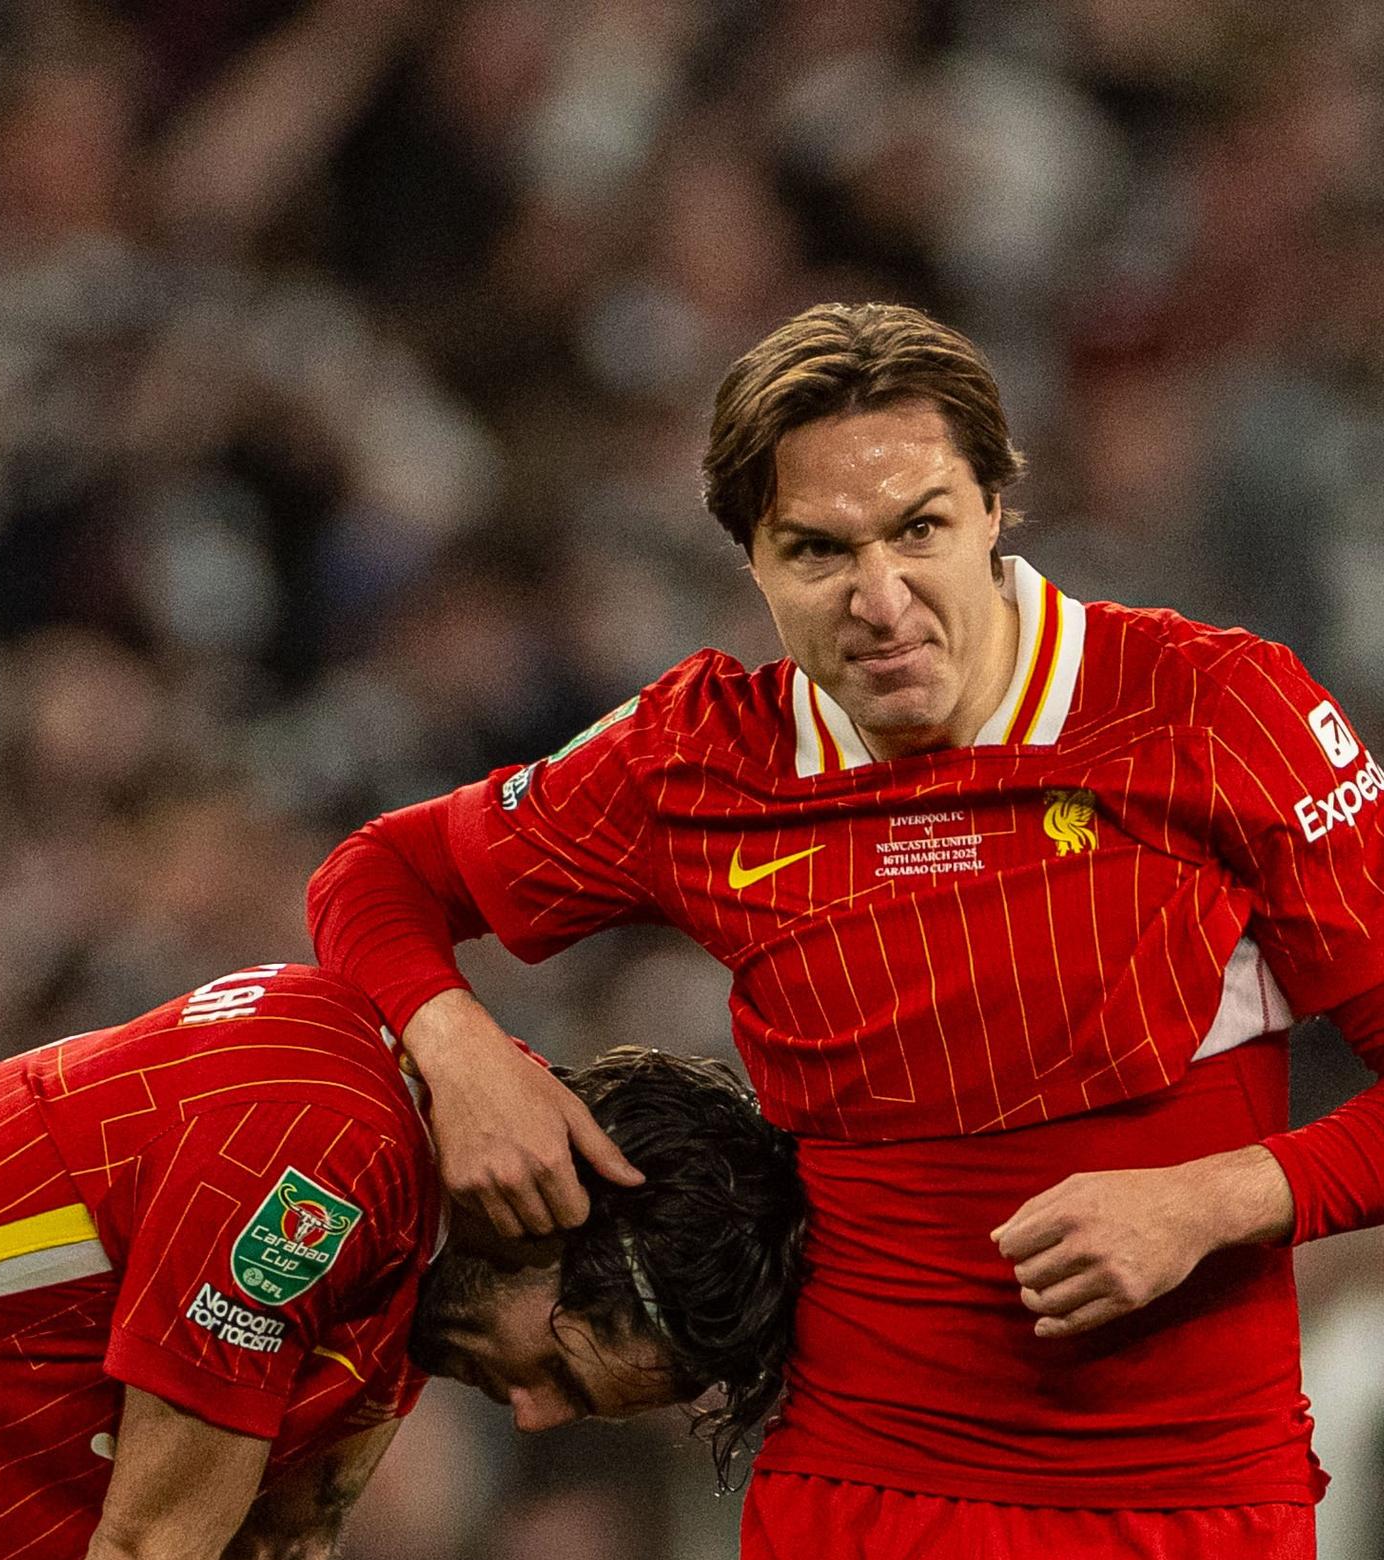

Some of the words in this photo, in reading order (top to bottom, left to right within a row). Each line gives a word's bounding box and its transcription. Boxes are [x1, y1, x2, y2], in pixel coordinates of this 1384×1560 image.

[891, 812, 950, 827] LIVERPOOL
[951, 810, 965, 821] FC
[876, 840, 940, 853] NEWCASTLE
[941, 834, 983, 847] UNITED
[883, 854, 908, 865] 16TH
[910, 850, 951, 863] MARCH
[952, 848, 977, 860] 2025
[875, 864, 929, 877] CARABAO
[930, 862, 952, 873] CUP
[953, 860, 985, 872] FINAL
[181, 963, 287, 1025] LAI
[251, 1225, 330, 1263] Carabao
[261, 1247, 300, 1273] Cup
[260, 1279, 284, 1299] EFL
[195, 1282, 228, 1318] No
[227, 1305, 285, 1336] room
[218, 1323, 283, 1353] racism
